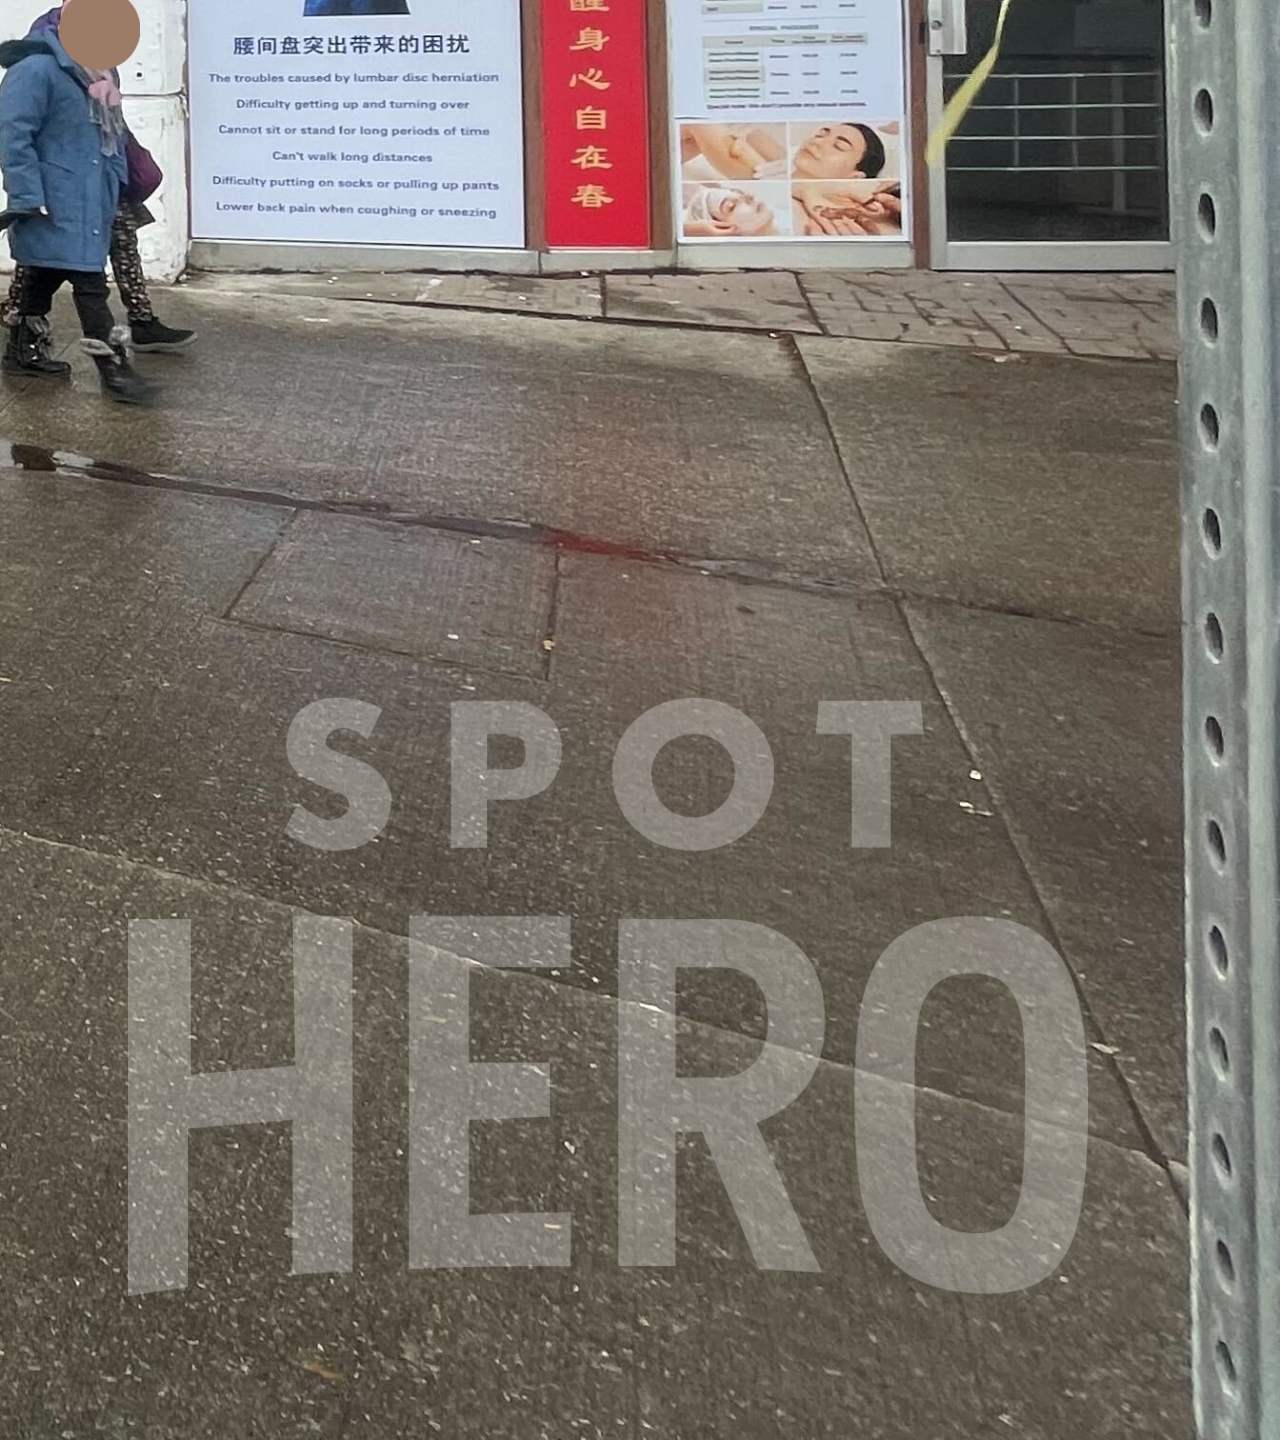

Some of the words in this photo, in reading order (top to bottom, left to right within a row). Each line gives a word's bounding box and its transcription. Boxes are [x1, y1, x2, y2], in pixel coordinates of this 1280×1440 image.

[233, 34, 470, 56] 腰间盘突出带来的困扰
[208, 74, 231, 83] The
[234, 73, 284, 82] troubles
[288, 73, 331, 82] caused
[335, 73, 350, 84] by
[354, 73, 399, 82] lumbar
[402, 73, 428, 82] disc
[432, 73, 499, 82] herniation
[236, 99, 291, 110] Difficulty
[295, 99, 339, 110] getting
[343, 102, 358, 110] up
[362, 100, 386, 108] and
[389, 99, 437, 111] turning
[440, 99, 470, 109] over
[219, 125, 262, 134] Cannot
[266, 125, 281, 134] sit
[301, 126, 335, 135] stand
[339, 126, 356, 135] for
[360, 126, 388, 137] long
[391, 126, 440, 137] periods
[444, 126, 456, 136] of
[461, 127, 490, 136] time
[272, 151, 304, 160] Can't
[307, 152, 337, 161] walk
[341, 152, 368, 163] long
[372, 152, 433, 162] distances
[213, 176, 266, 187] Difficulty
[270, 175, 314, 189] putting
[338, 179, 373, 188] socks
[394, 180, 438, 191] pulling
[442, 183, 458, 191] up
[463, 182, 499, 191] pants
[216, 202, 253, 211] Lower
[258, 203, 285, 212] back
[289, 203, 315, 214] pain
[319, 204, 353, 213] when
[358, 206, 417, 217] coughing
[438, 208, 496, 219] sneezing
